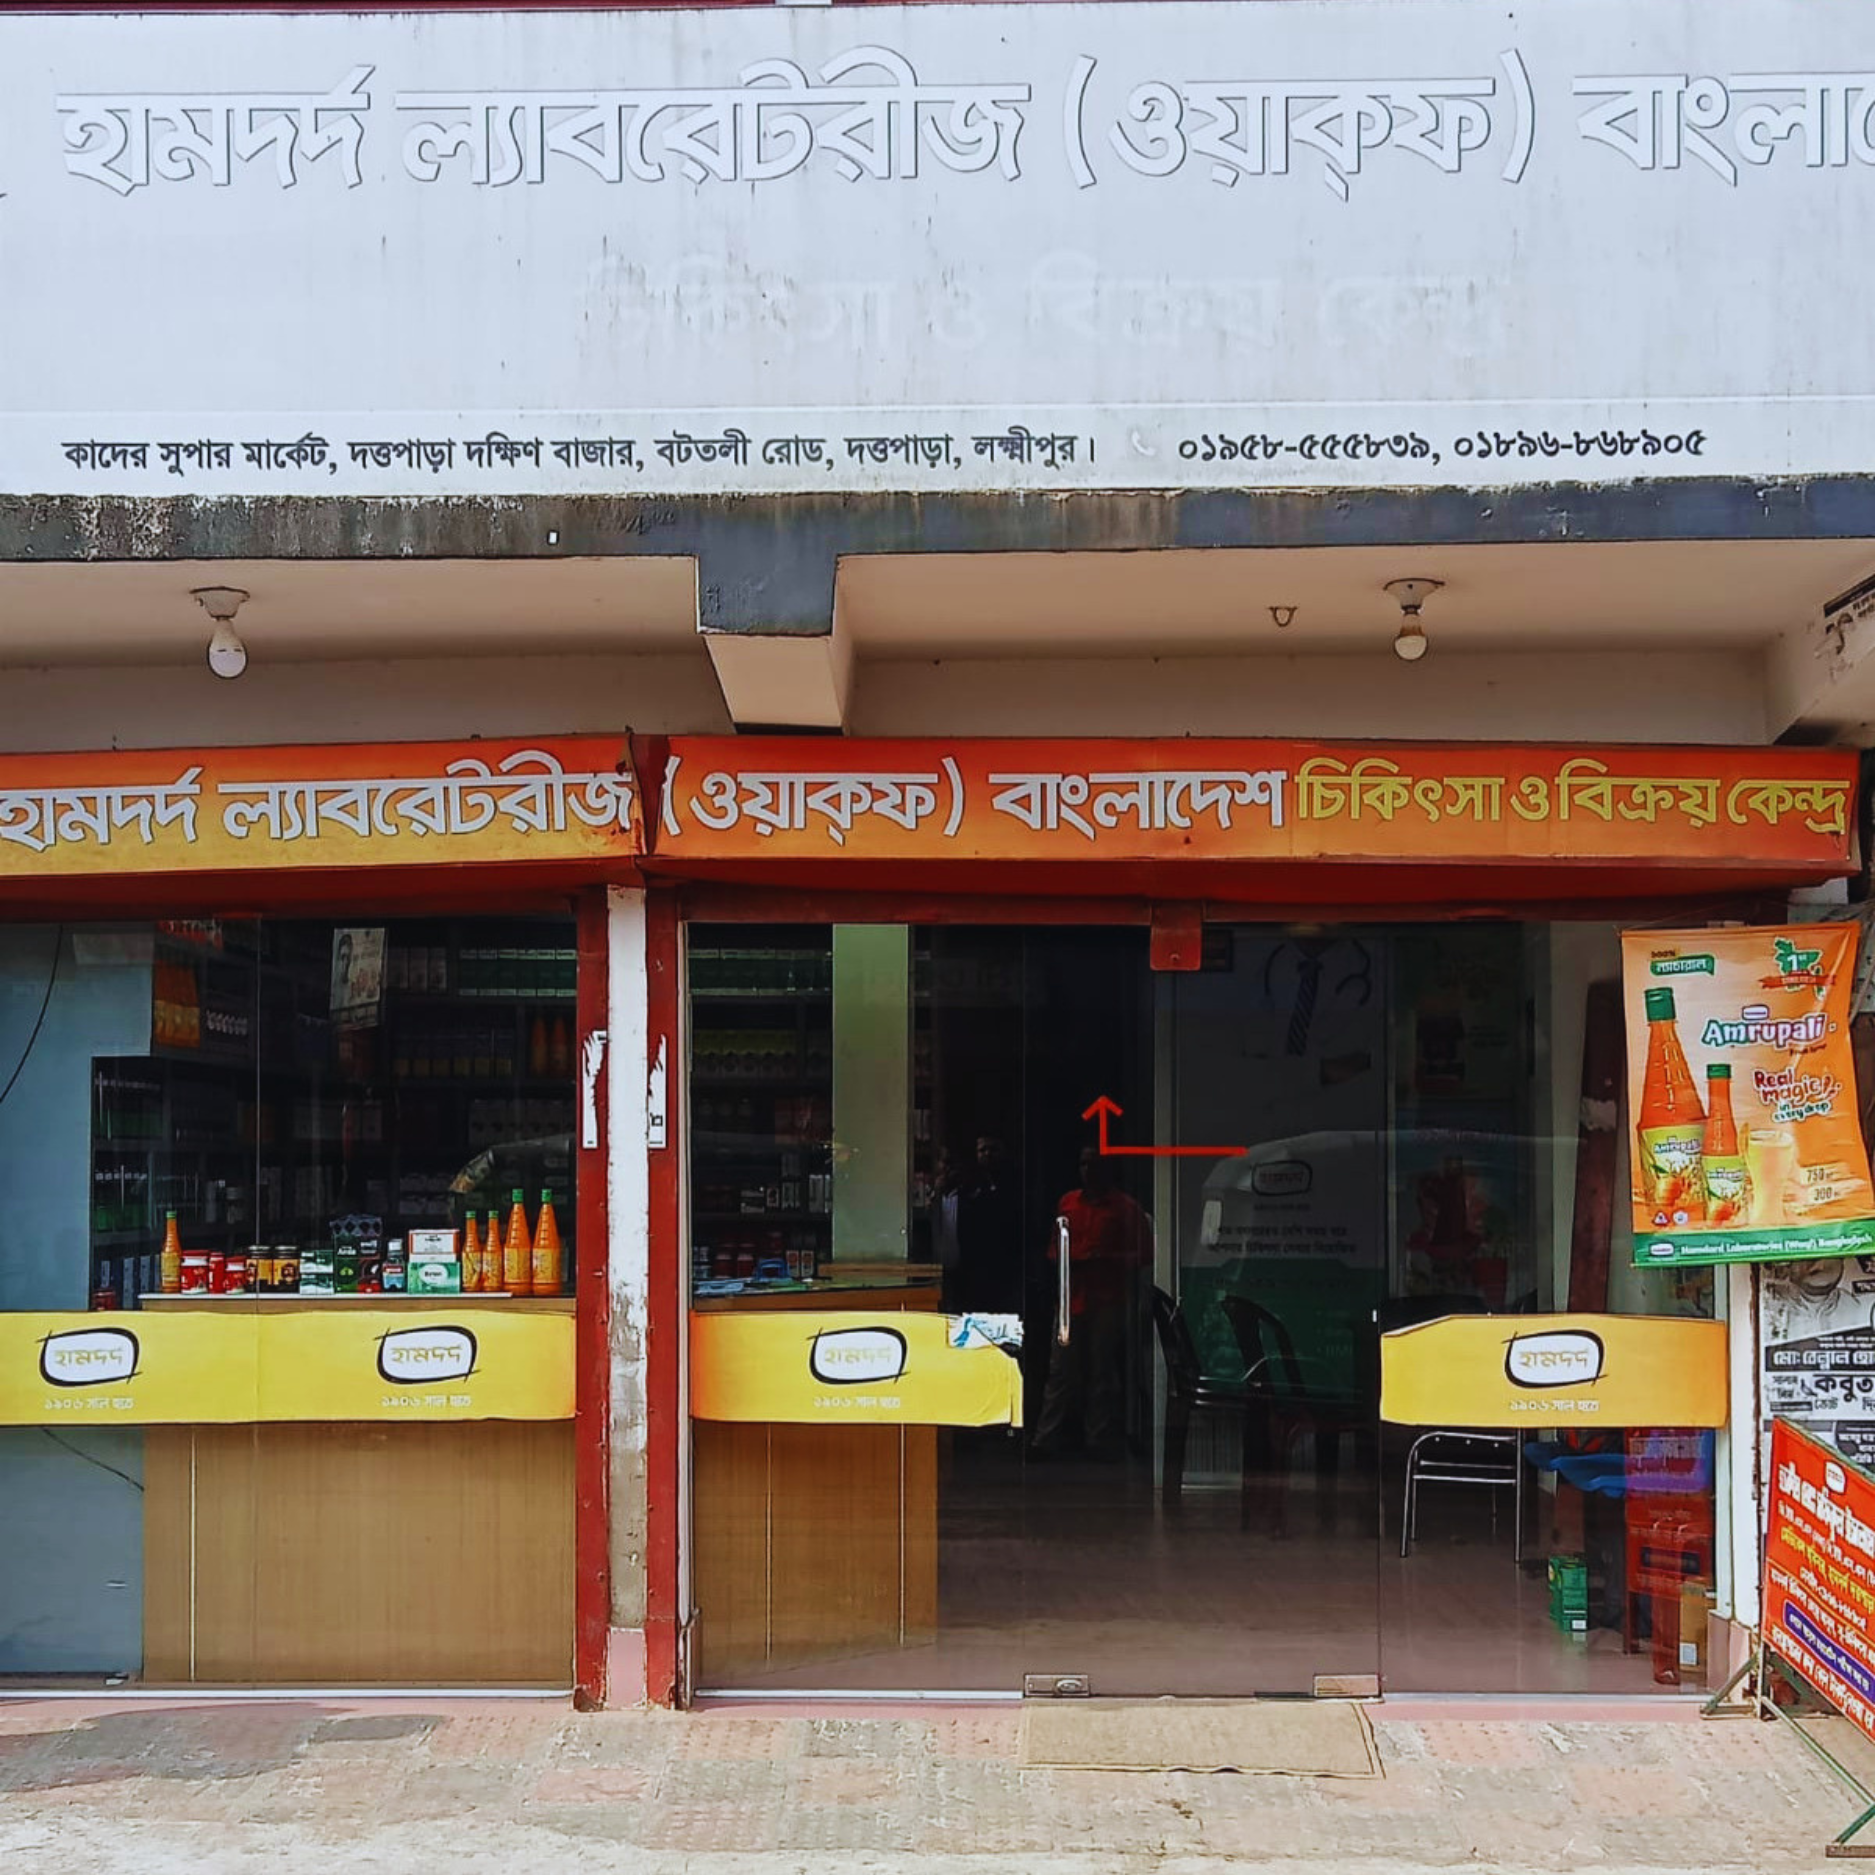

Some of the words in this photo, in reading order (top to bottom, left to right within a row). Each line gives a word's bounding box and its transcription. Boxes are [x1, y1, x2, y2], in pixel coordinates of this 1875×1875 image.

[56, 64, 377, 198] হামদর্দ
[395, 44, 1032, 188] ল্যাবরেটরীজ
[62, 439, 150, 470] কাদের
[158, 438, 234, 477] সুপার
[242, 432, 337, 475] মার্কেট,
[348, 438, 457, 474] দত্তপাড়া
[463, 431, 544, 469] দক্ষিণ
[552, 436, 644, 473] বাজার,
[655, 429, 751, 467] বটতলী
[762, 436, 834, 471] রোড,
[844, 434, 962, 470] দত্তপাড়া,
[1179, 431, 1441, 467] ০১৯৫৮-৫৫৫৮৩৯,
[1454, 430, 1709, 458] ০১৮৯৬-৮৬৮৯০৫
[0, 767, 203, 852] হামদর্দ
[217, 749, 634, 842] ল্যাবরেটরীজ
[988, 770, 1287, 841] বাংলাদেশ
[1295, 757, 1505, 823] চিকিৎসা
[1510, 776, 1549, 823] ও
[1555, 757, 1720, 828] বিক্রয়
[1727, 780, 1851, 835] কেন্দ্র
[1704, 1015, 1825, 1047] Amrupali
[1754, 1068, 1793, 1088] Real
[1761, 1077, 1820, 1102] magic
[1806, 1167, 1825, 1182] 750
